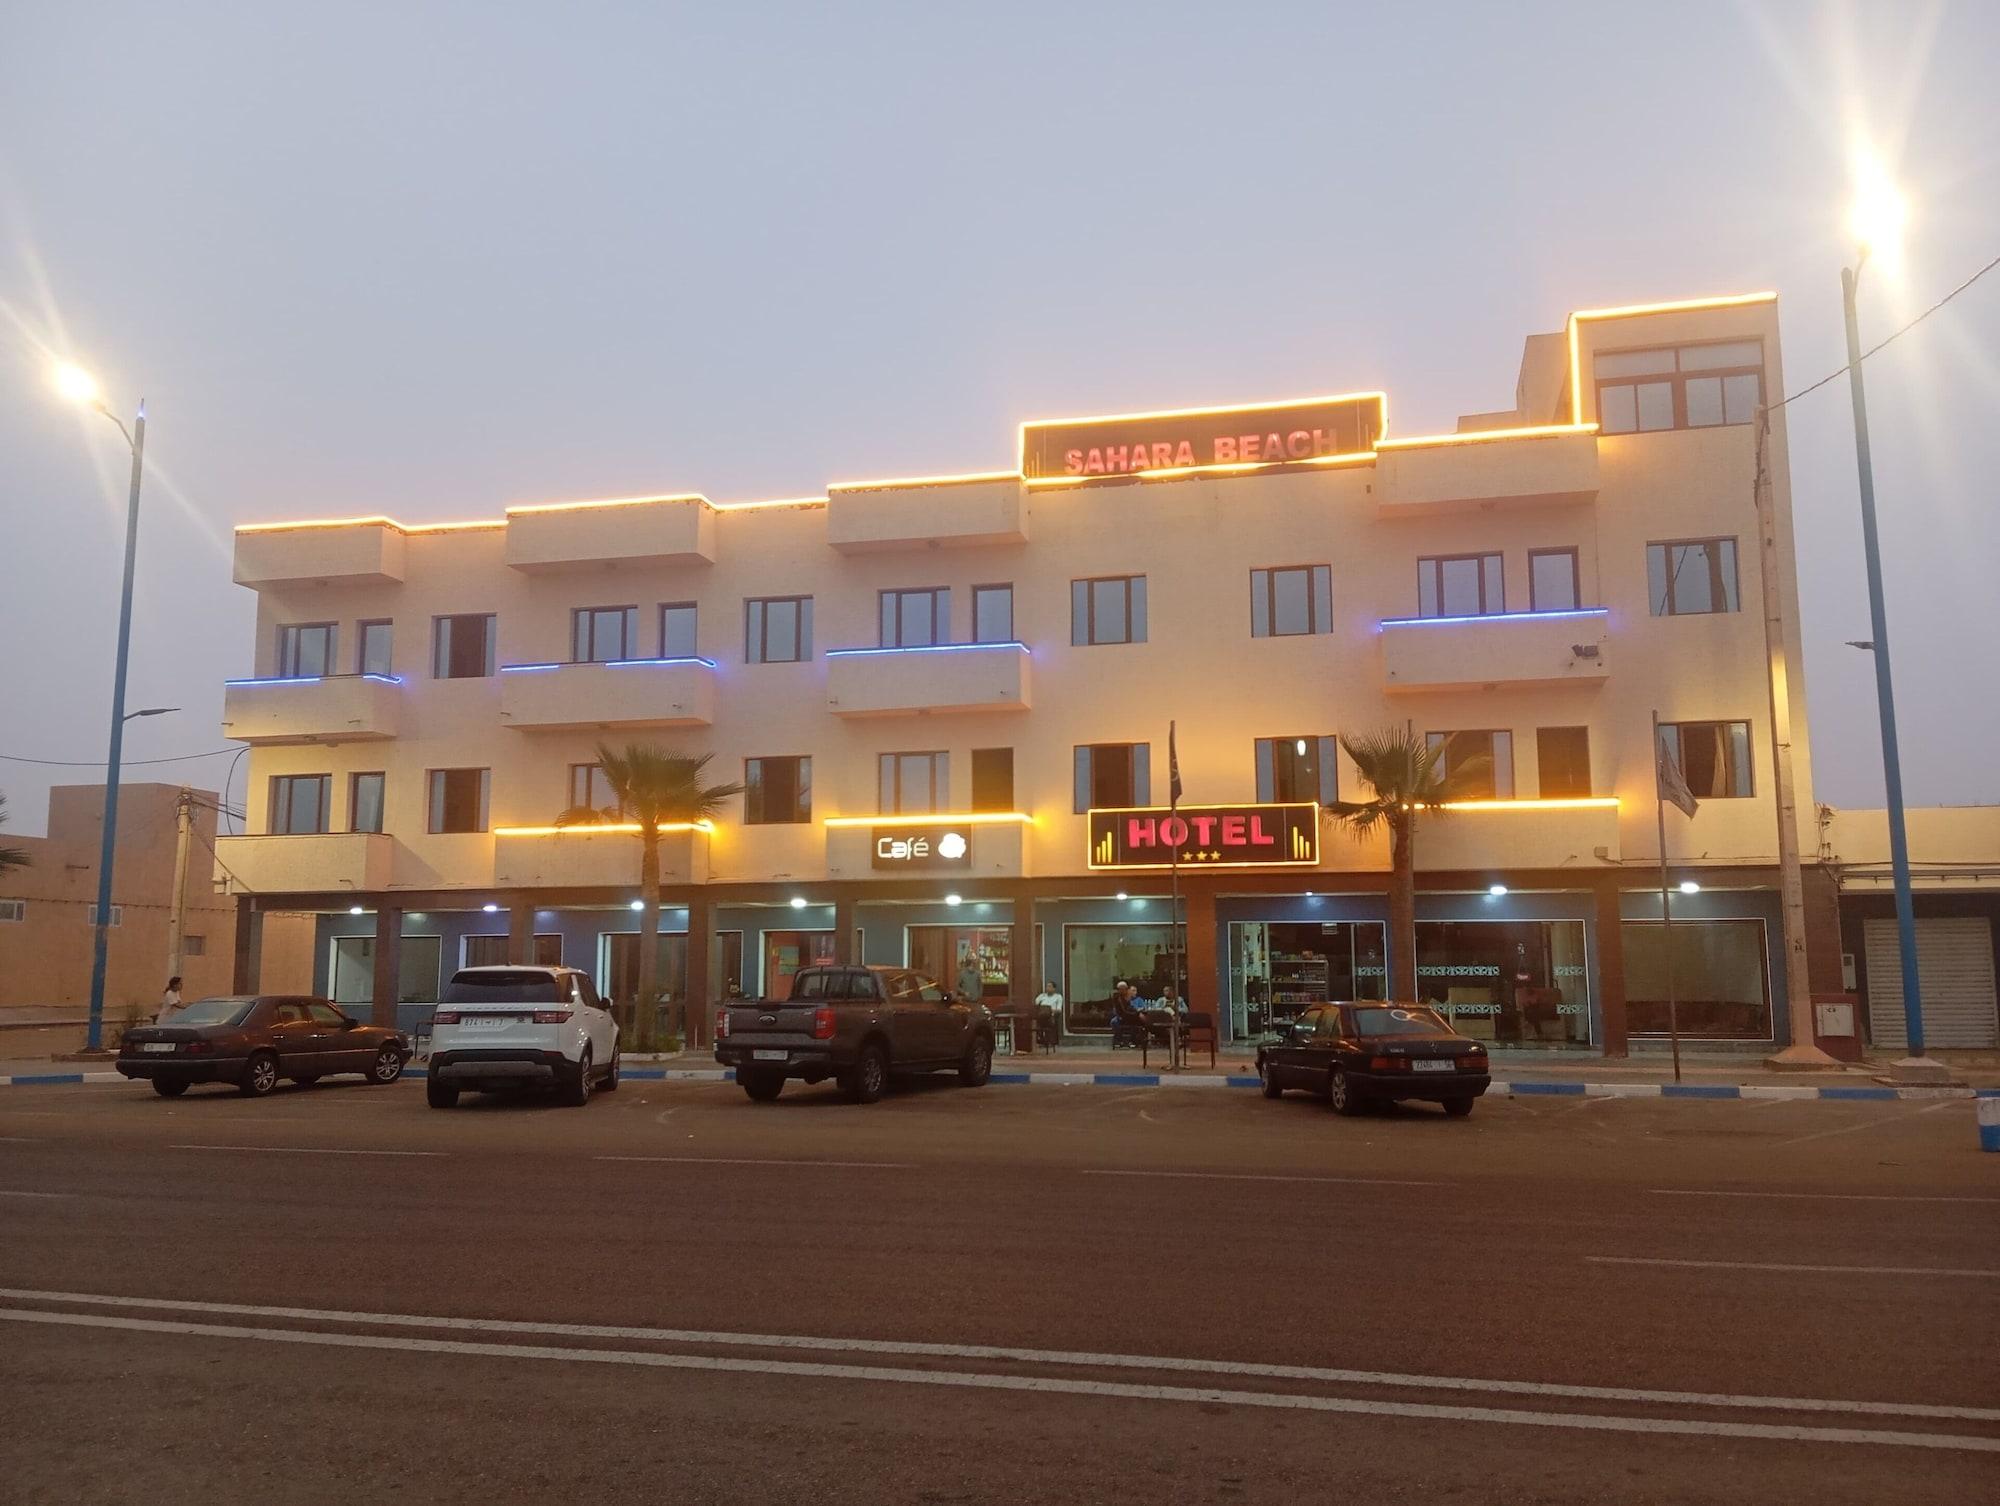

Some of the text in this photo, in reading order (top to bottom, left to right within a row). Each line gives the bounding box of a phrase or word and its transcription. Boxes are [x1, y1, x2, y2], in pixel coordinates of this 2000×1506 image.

[1064, 428, 1337, 475] SAHARA BEACH
[877, 836, 929, 860] Café
[1128, 815, 1275, 848] HOTEL
